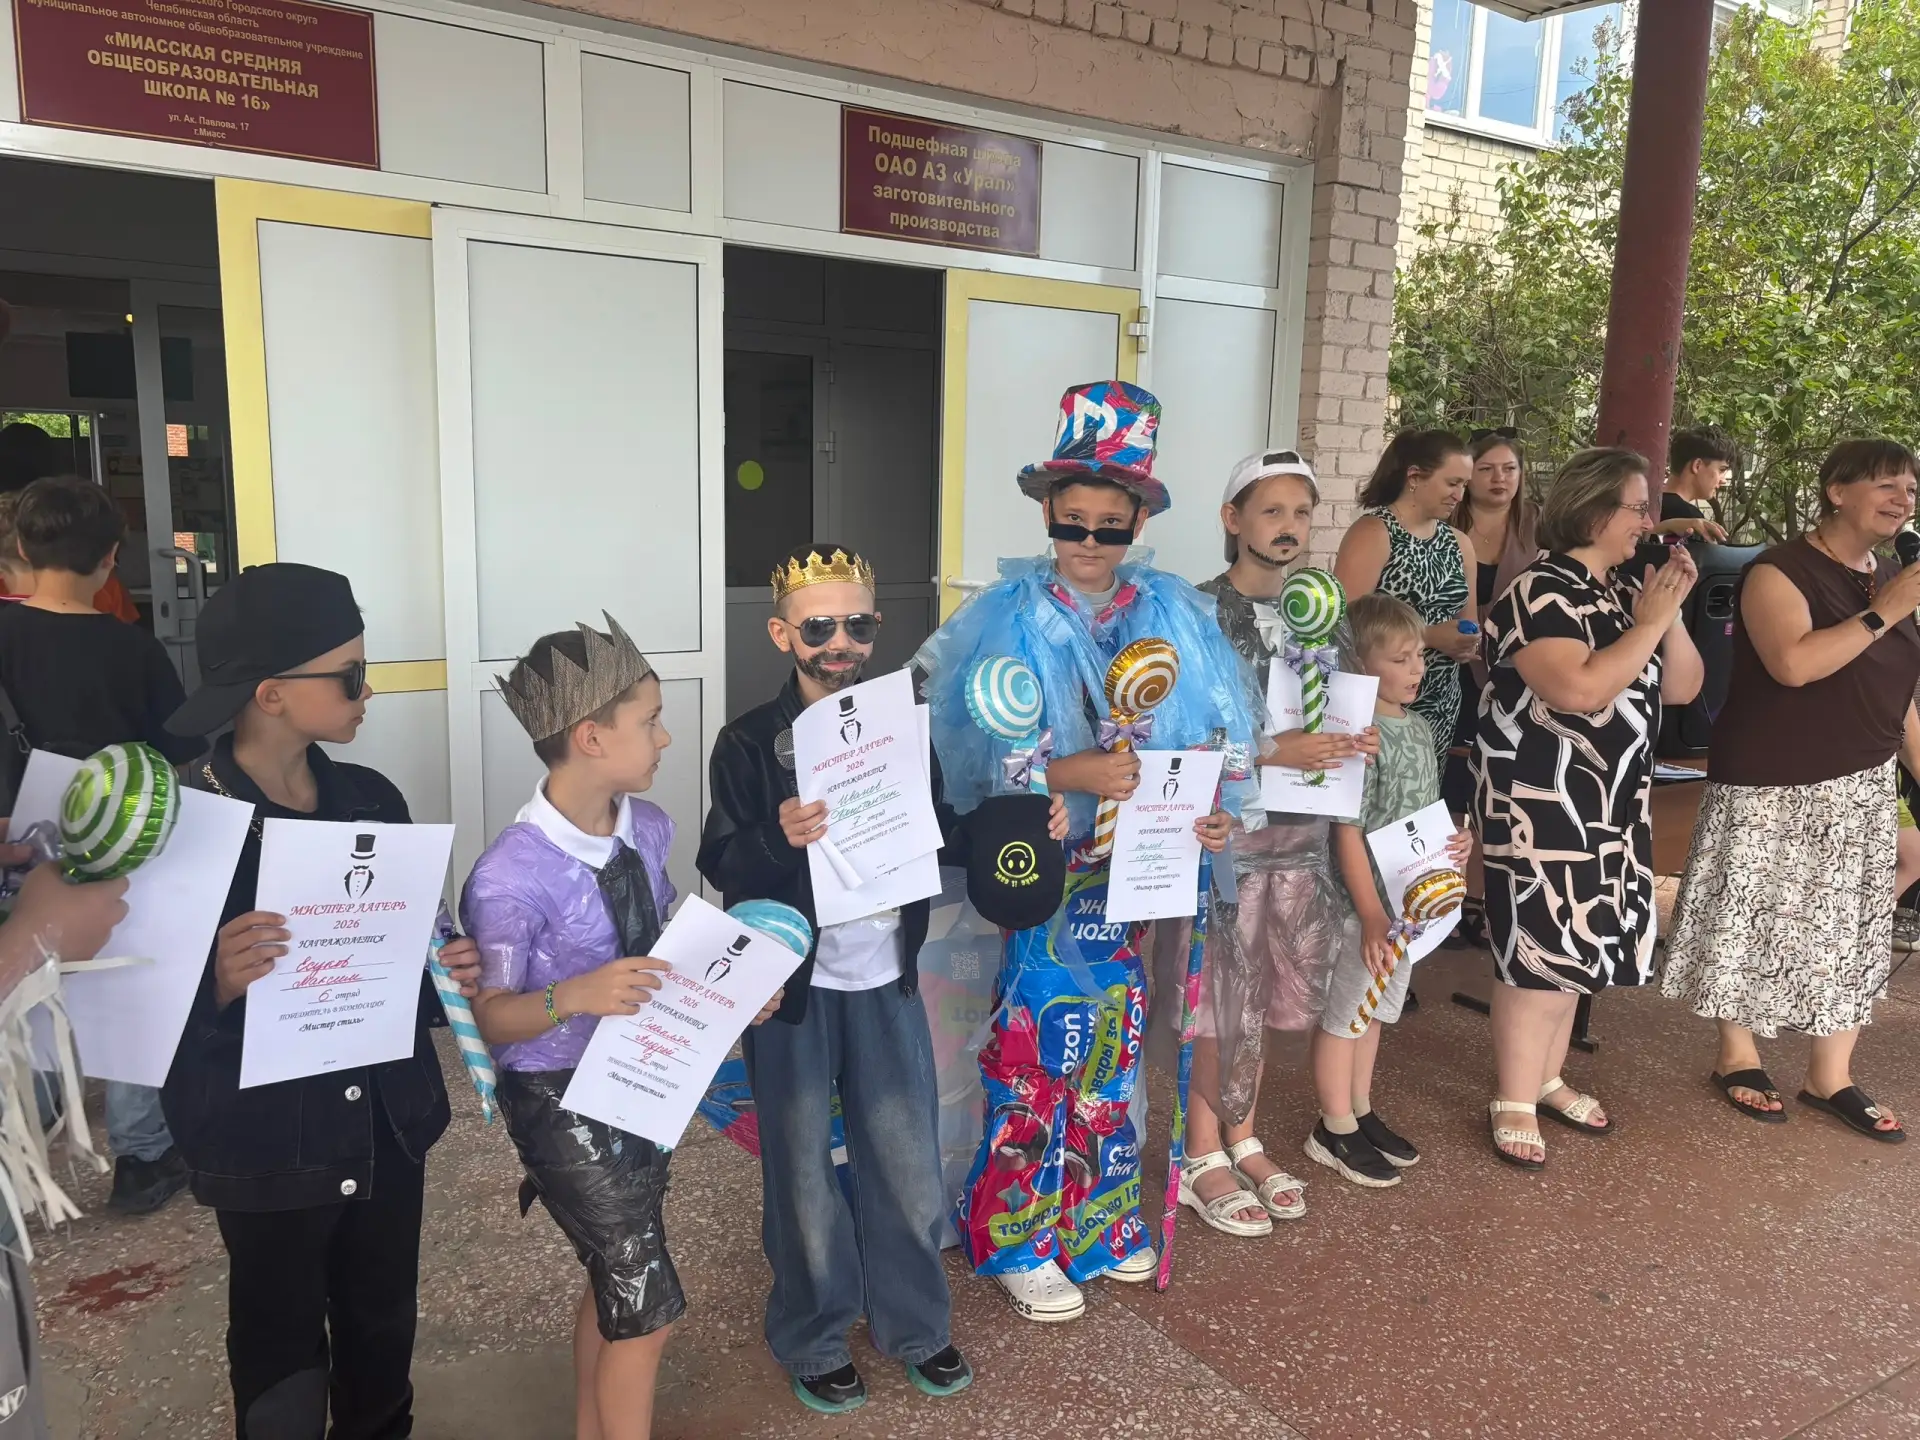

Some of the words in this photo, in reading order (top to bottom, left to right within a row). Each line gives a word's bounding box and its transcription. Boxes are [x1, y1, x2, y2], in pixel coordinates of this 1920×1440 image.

[146, 0, 215, 20] Челябинская
[217, 12, 259, 28] область
[226, 0, 283, 19] Городского
[286, 11, 318, 26] округа
[121, 11, 186, 29] автономное
[188, 21, 304, 49] общеобразовательное
[306, 41, 364, 60] учреждение
[104, 31, 216, 61] «МИАССКАЯ
[221, 49, 302, 75] СРЕДНЯЯ
[87, 49, 319, 99] ОБЩЕОБРАЗОВАТЕЛЬНАЯ
[144, 79, 211, 103] ШКОЛА
[216, 90, 236, 106] №
[241, 94, 271, 112] 16»
[168, 112, 181, 123] ул.
[184, 114, 197, 124] Ак.
[199, 116, 238, 131] Павлова,
[240, 122, 249, 131] 17
[193, 127, 227, 139] г.Миасс
[868, 125, 967, 159] Подшефная
[973, 146, 1022, 168] школа
[875, 152, 917, 177] ОАО
[922, 160, 947, 182] АЗ
[952, 165, 1015, 192] «Урал»
[873, 184, 1016, 218] заготовительного
[890, 211, 1000, 239] производства
[812, 749, 856, 775] МИСТЕР
[856, 735, 895, 757] ЛАГЕРЬ
[846, 759, 865, 773] 2026
[826, 763, 888, 794] НАГРАЖДАЕТСЯ
[290, 903, 355, 916] МИСТЕР
[354, 901, 407, 913] ЛАГЕРЬ
[333, 919, 361, 929] 2026
[298, 934, 387, 948] НАГРАЖДАЕТСЯ
[318, 988, 333, 1002] 6
[335, 988, 361, 1001] отряд
[679, 995, 700, 1009] 2026
[700, 988, 736, 1010] ЛАГЕРЬ
[1127, 985, 1143, 1055] OZON
[1061, 1013, 1082, 1075] ozon
